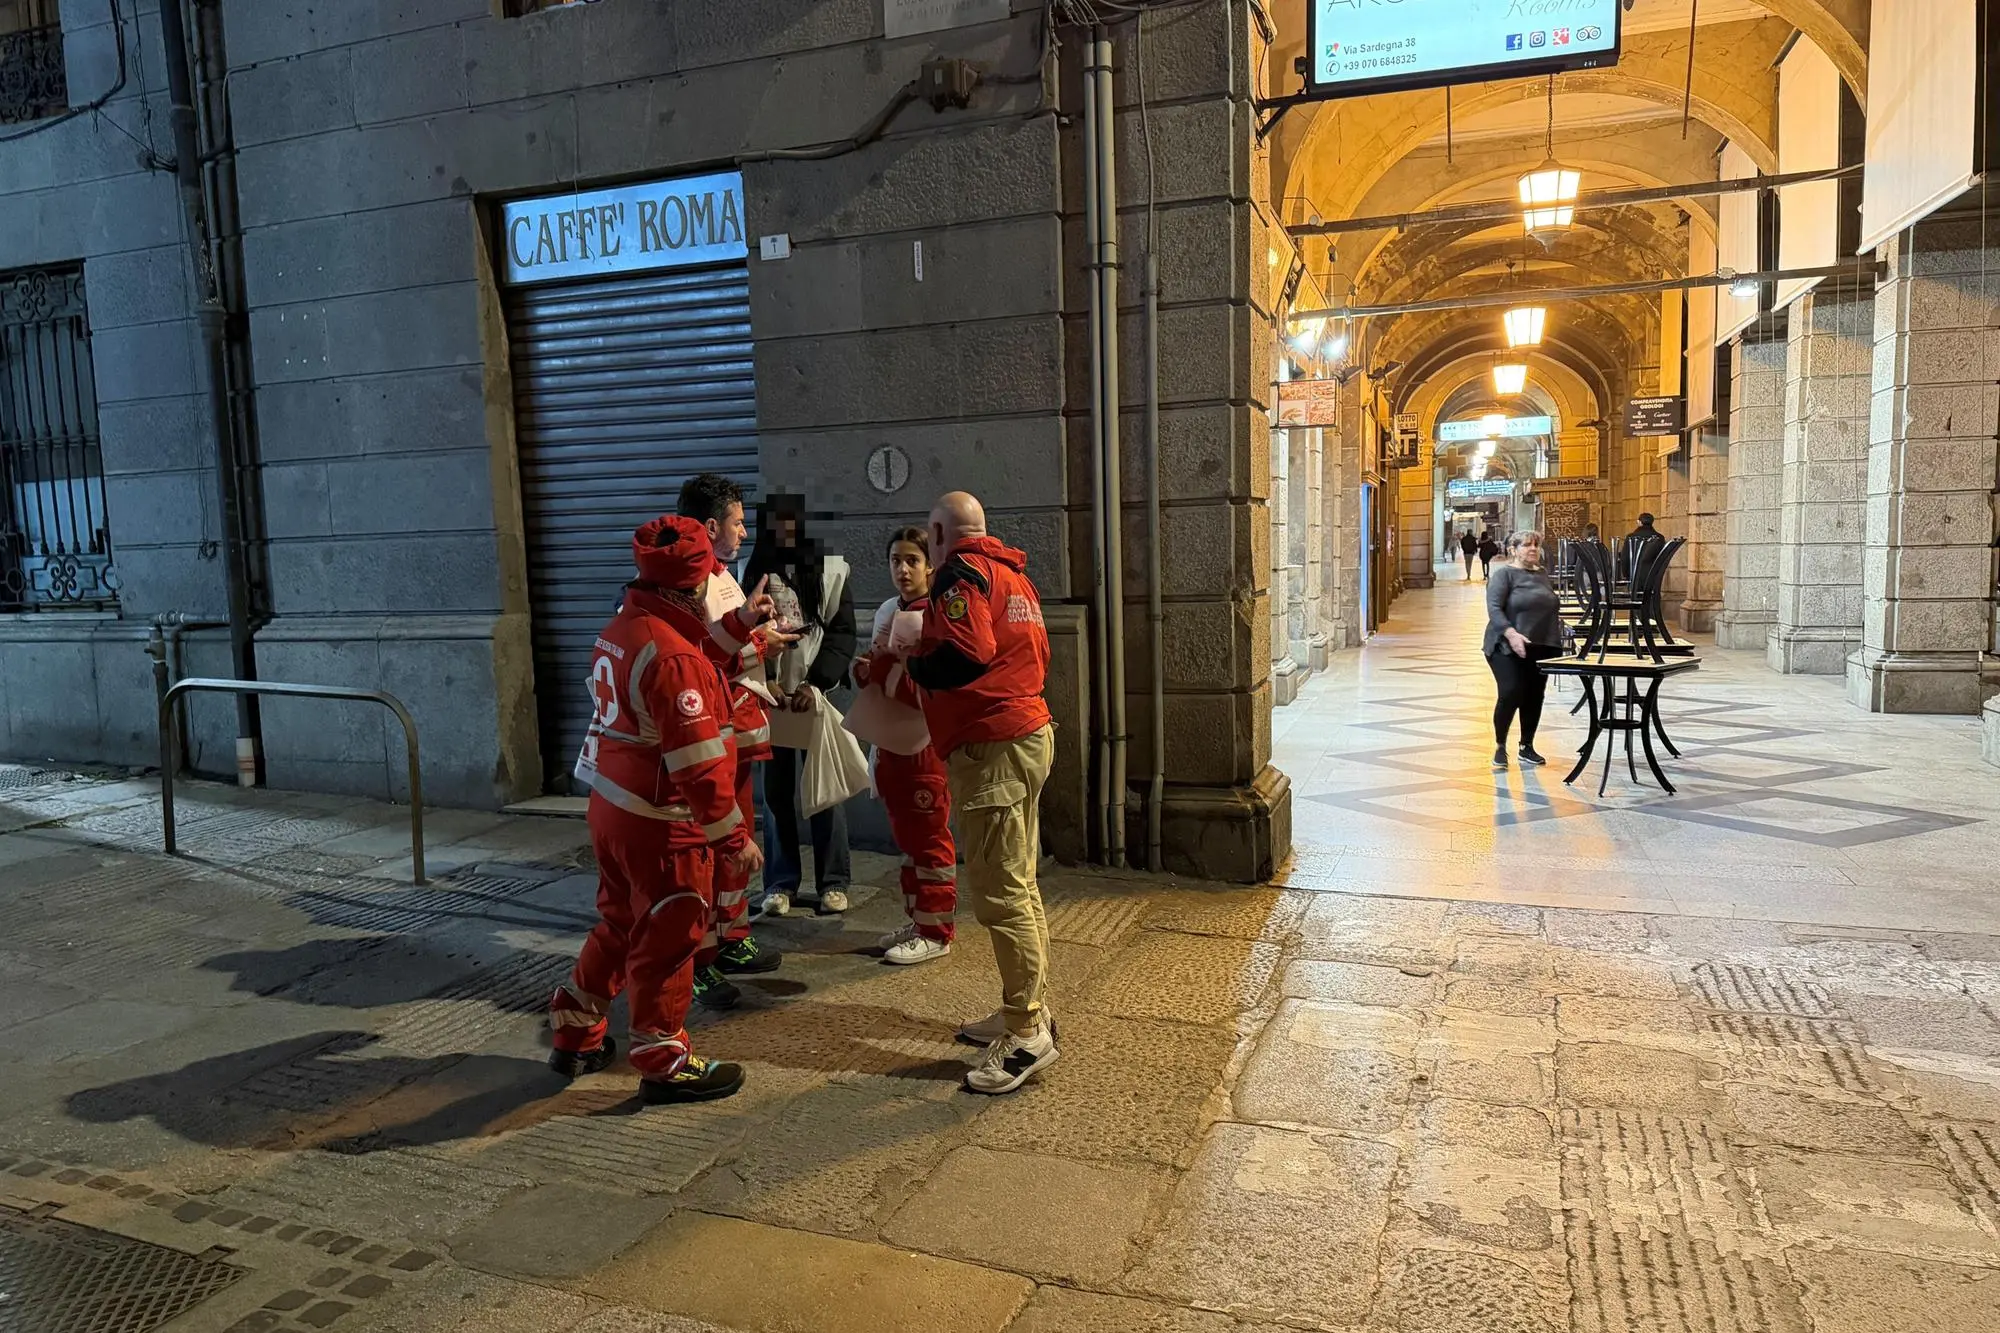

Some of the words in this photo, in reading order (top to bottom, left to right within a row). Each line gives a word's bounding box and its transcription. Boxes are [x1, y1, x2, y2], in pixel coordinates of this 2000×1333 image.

[1343, 45, 1358, 55] Via
[1359, 41, 1403, 53] Sardegna
[1405, 37, 1416, 48] 38
[1343, 61, 1359, 70] +39
[1361, 58, 1378, 69] 070
[1379, 54, 1417, 67] 6848325
[510, 202, 624, 268] CAFFE'
[636, 188, 743, 254] ROMA
[1397, 415, 1416, 423] LOTTO
